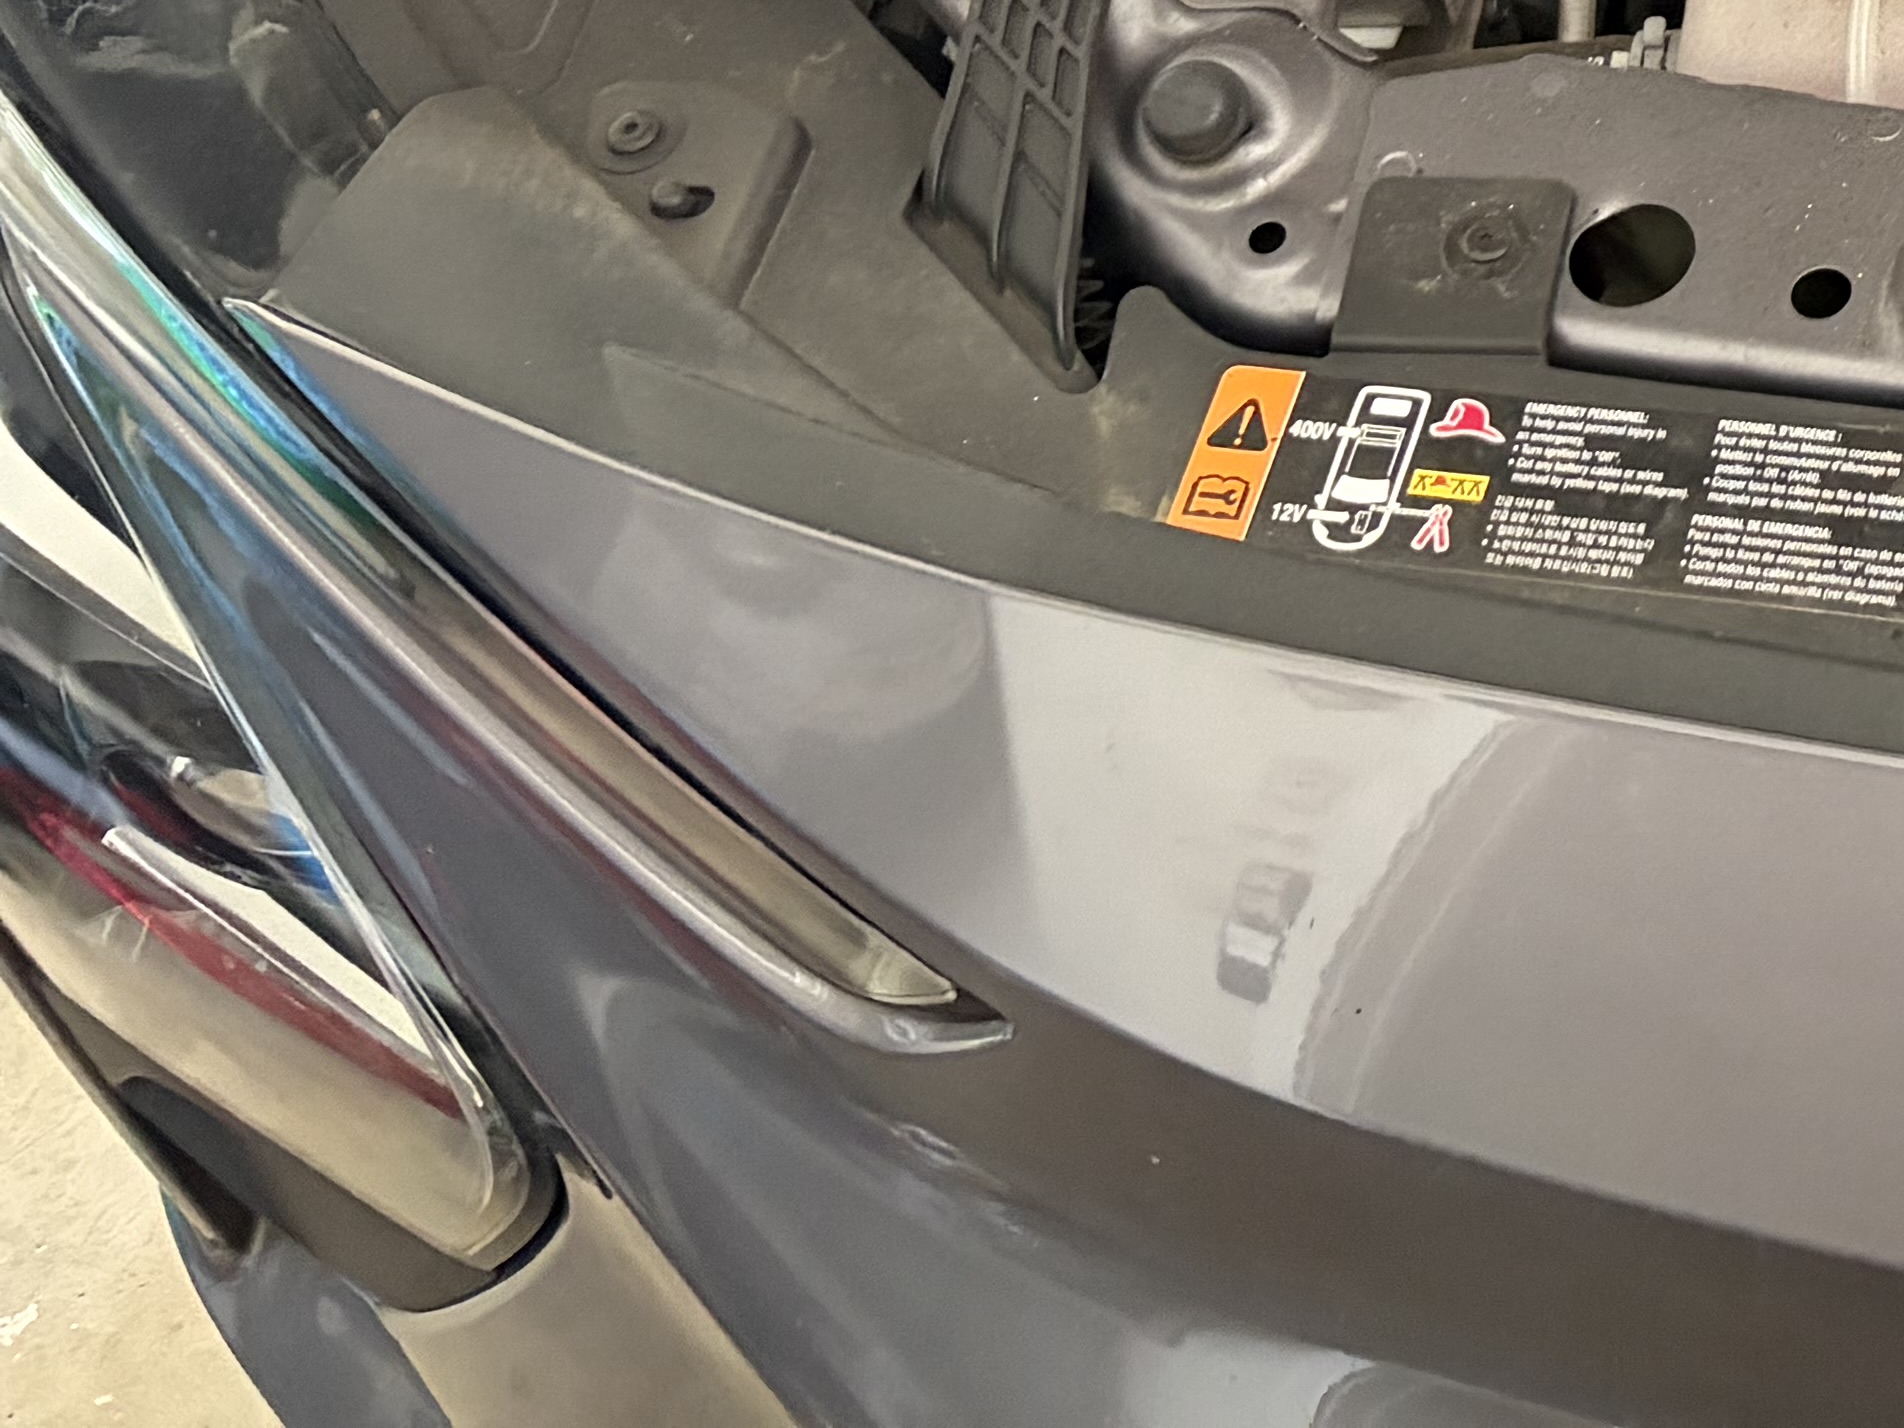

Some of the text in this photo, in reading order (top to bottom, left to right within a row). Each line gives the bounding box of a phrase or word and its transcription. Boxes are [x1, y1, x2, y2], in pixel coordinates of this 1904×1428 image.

[1524, 402, 1650, 424] EMERGENCY PERSONNEL:
[1289, 419, 1337, 440] 400V
[1521, 415, 1667, 441] To help avoid personal injury in
[1717, 419, 1837, 442] PERSONNEL D'URGENCE
[1522, 444, 1542, 456] Turn
[1543, 447, 1580, 460] ignition
[1581, 450, 1592, 461] to
[1714, 434, 1738, 446] Pour
[1769, 438, 1798, 451] toutes
[1800, 441, 1847, 457] blessures
[1849, 448, 1902, 464] corporelles
[1515, 457, 1664, 482] Cut any battery cables or wires
[1511, 472, 1549, 486] marked
[1550, 476, 1563, 489] by
[1563, 477, 1597, 492] yellow
[1597, 480, 1619, 493] tape
[1620, 482, 1643, 495] (see
[1271, 502, 1307, 522] 12V
[1691, 513, 1833, 539] PERSONAL DE EMERGENCIA:
[1688, 557, 1795, 581] Corte todos los cables
[1683, 574, 1733, 589] marcados
[1734, 580, 1754, 590] con
[1755, 579, 1780, 594] cinta
[1781, 583, 1822, 599] amarilla
